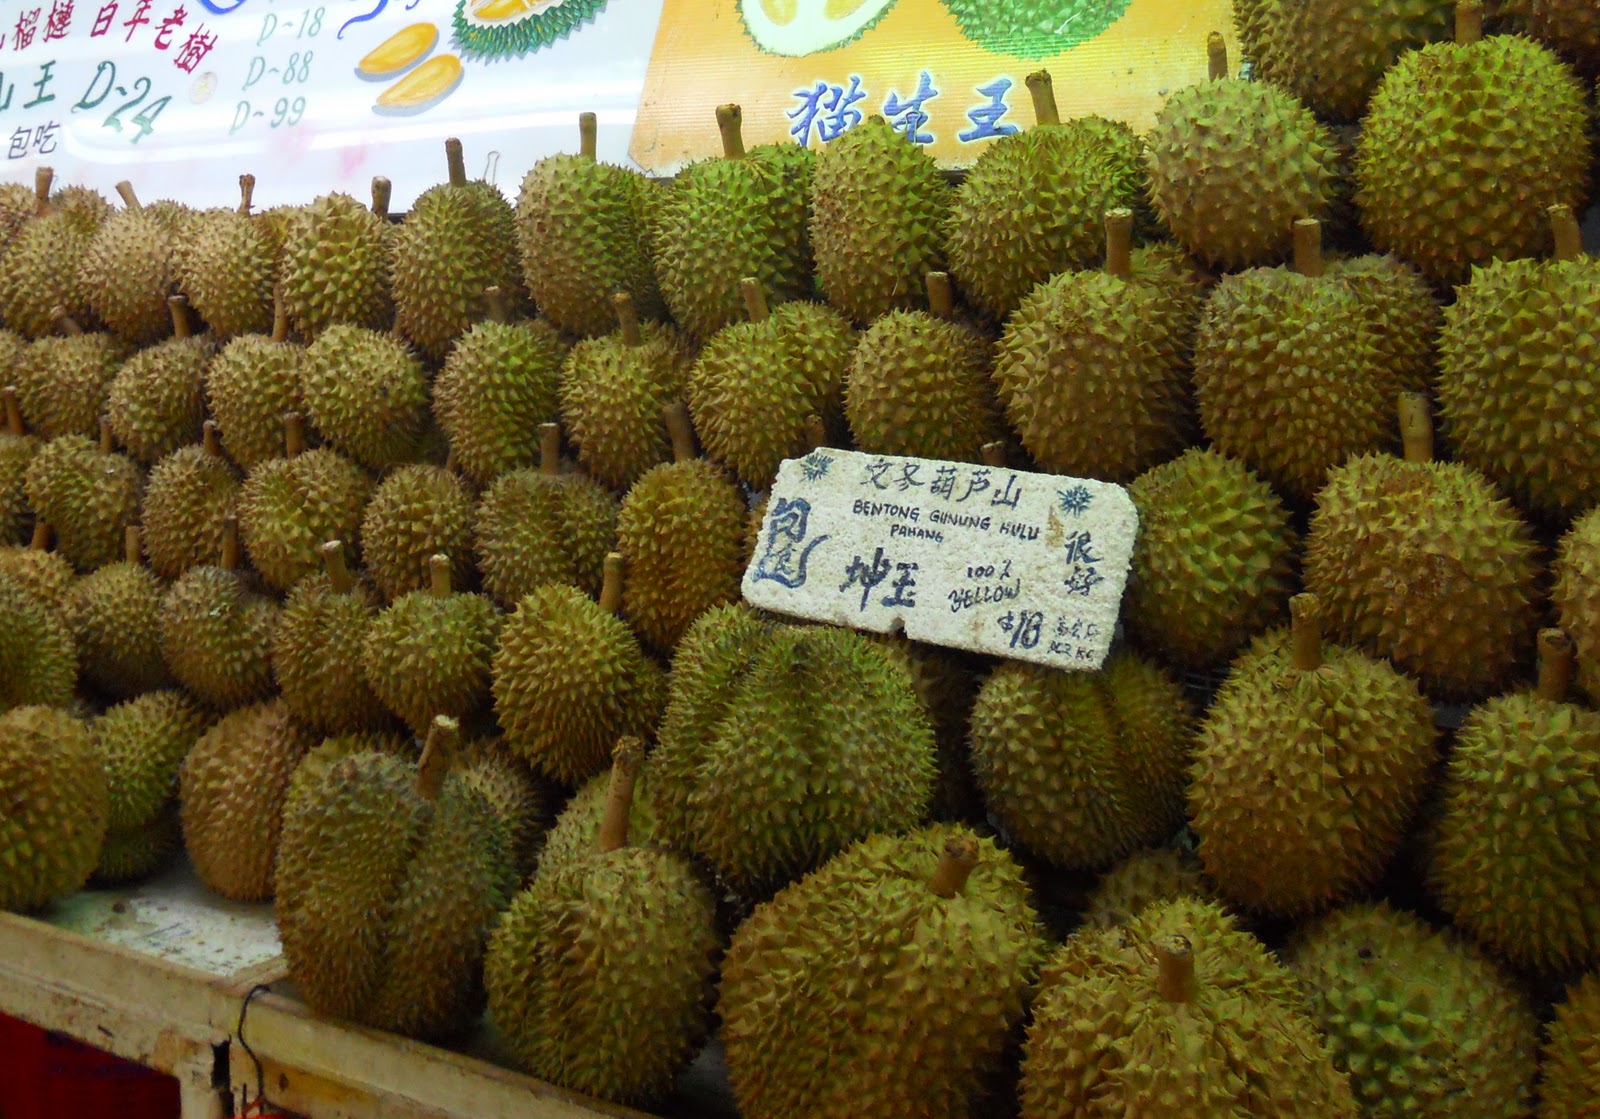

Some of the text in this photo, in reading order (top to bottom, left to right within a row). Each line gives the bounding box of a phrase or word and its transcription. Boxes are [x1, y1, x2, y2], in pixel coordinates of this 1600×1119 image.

[256, 6, 326, 47] D-18
[242, 50, 314, 91] D-88
[70, 60, 173, 145] D-24
[229, 96, 307, 136] D-99
[8, 120, 61, 160] 包吃
[853, 499, 1041, 541] BENTONG GUNUNG HULU
[890, 524, 945, 544] PAHANG
[947, 578, 1021, 613] YELLOW
